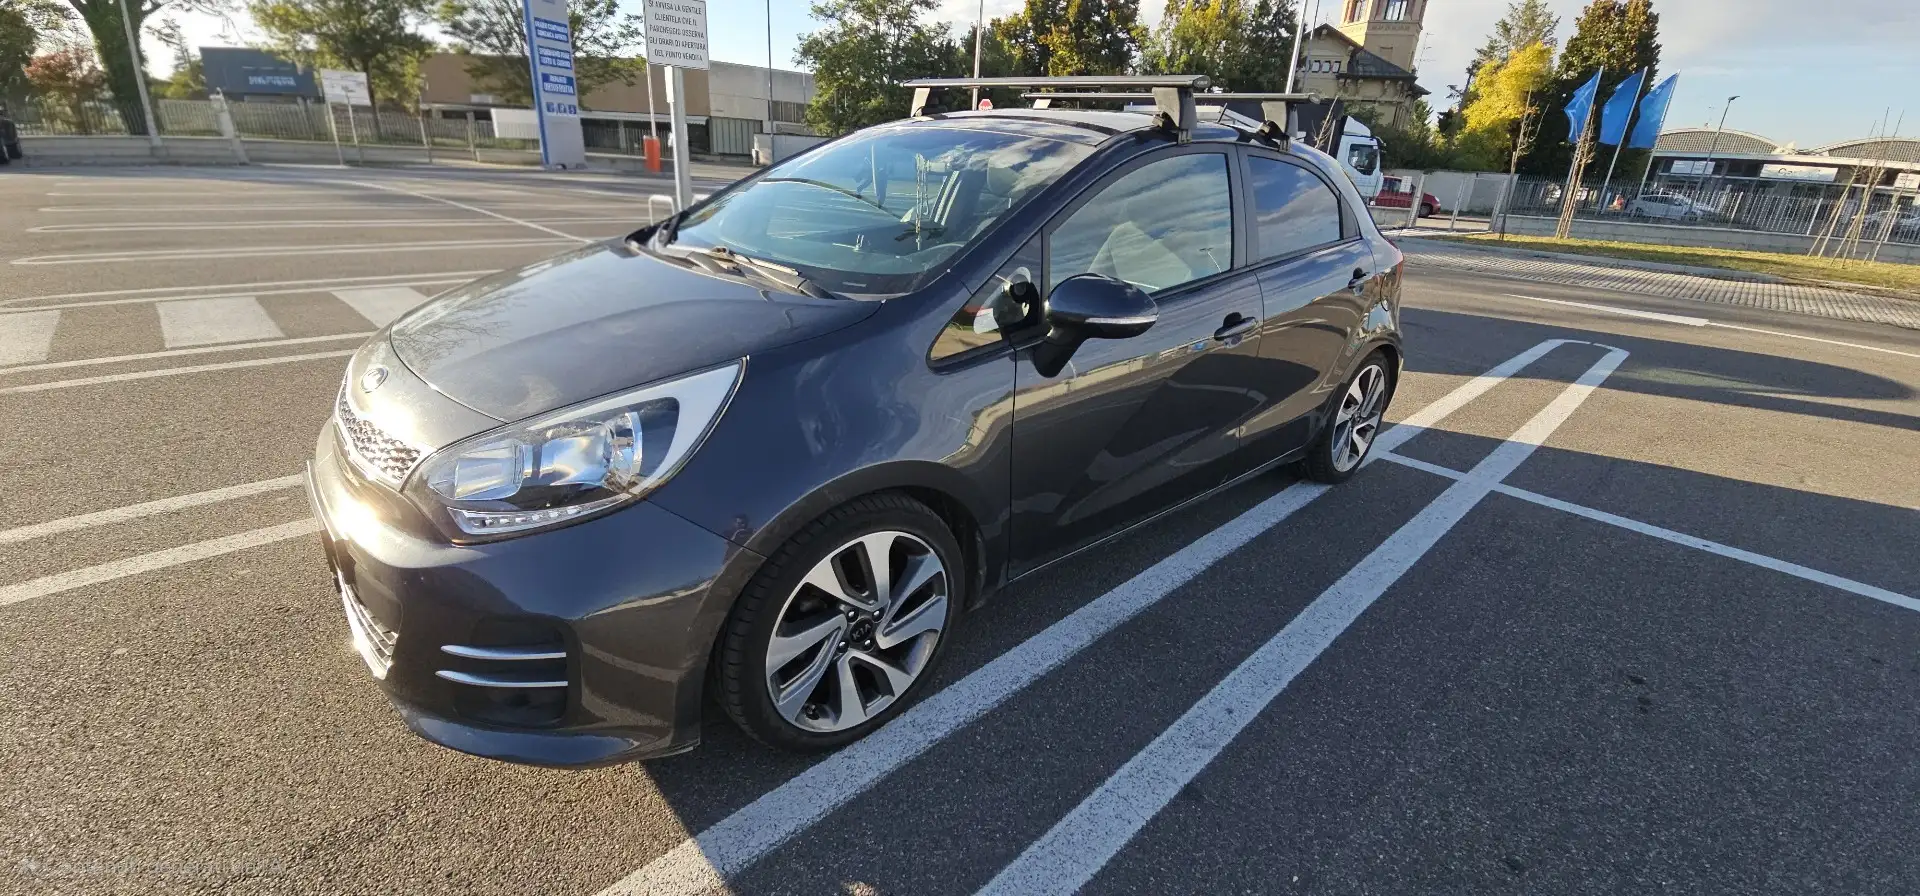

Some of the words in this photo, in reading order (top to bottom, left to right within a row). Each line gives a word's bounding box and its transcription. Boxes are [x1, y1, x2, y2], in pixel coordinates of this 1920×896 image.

[656, 1, 674, 10] AVVISA
[654, 13, 681, 24] CLIENTELA
[665, 50, 681, 59] PUNTO
[852, 624, 872, 640] KIA
